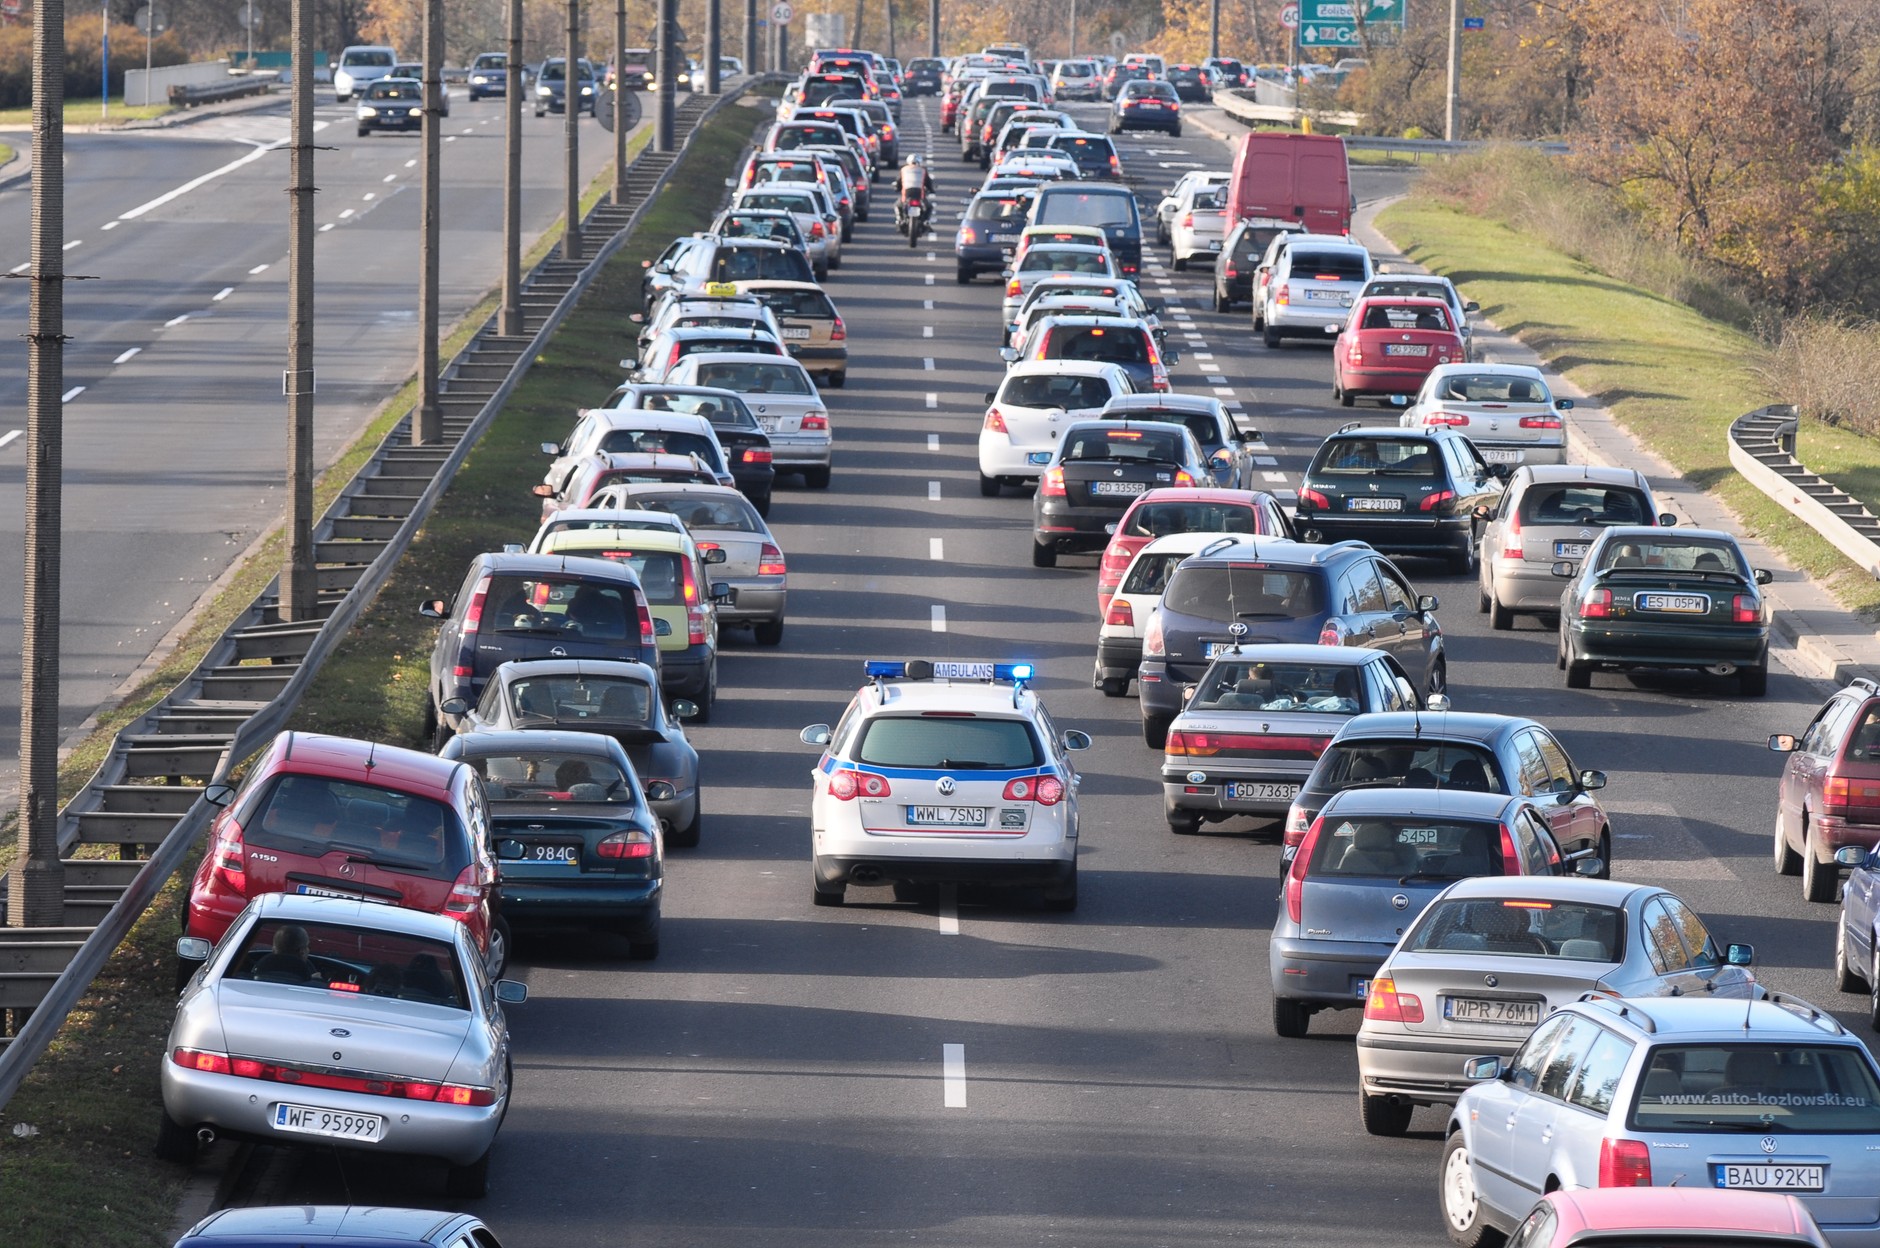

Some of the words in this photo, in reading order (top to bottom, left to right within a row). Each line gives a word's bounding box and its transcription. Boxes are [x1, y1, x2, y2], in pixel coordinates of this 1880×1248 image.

[775, 7, 791, 19] 60
[1098, 483, 1112, 492] GD
[1115, 483, 1143, 493] 3355R
[1354, 500, 1368, 509] WE
[1371, 500, 1399, 510] 23103
[1563, 545, 1578, 554] WE
[1648, 597, 1669, 607] ESI
[1674, 598, 1701, 608] 05PW
[934, 664, 993, 678] AMBULANS
[1236, 784, 1255, 797] GD
[1258, 784, 1298, 799] 7363F
[916, 807, 944, 821] WWL
[949, 808, 983, 822] 7SN3
[1400, 829, 1436, 843] 545P
[536, 846, 576, 861] 984C
[1456, 999, 1491, 1018] WPR
[1496, 1002, 1534, 1021] 76M1
[1660, 1091, 1866, 1107] www.auto-kozlowski.eu
[289, 1108, 316, 1128] WF
[321, 1113, 376, 1136] 95999
[1728, 1167, 1768, 1186] BAU
[1774, 1168, 1820, 1187] 92KH
